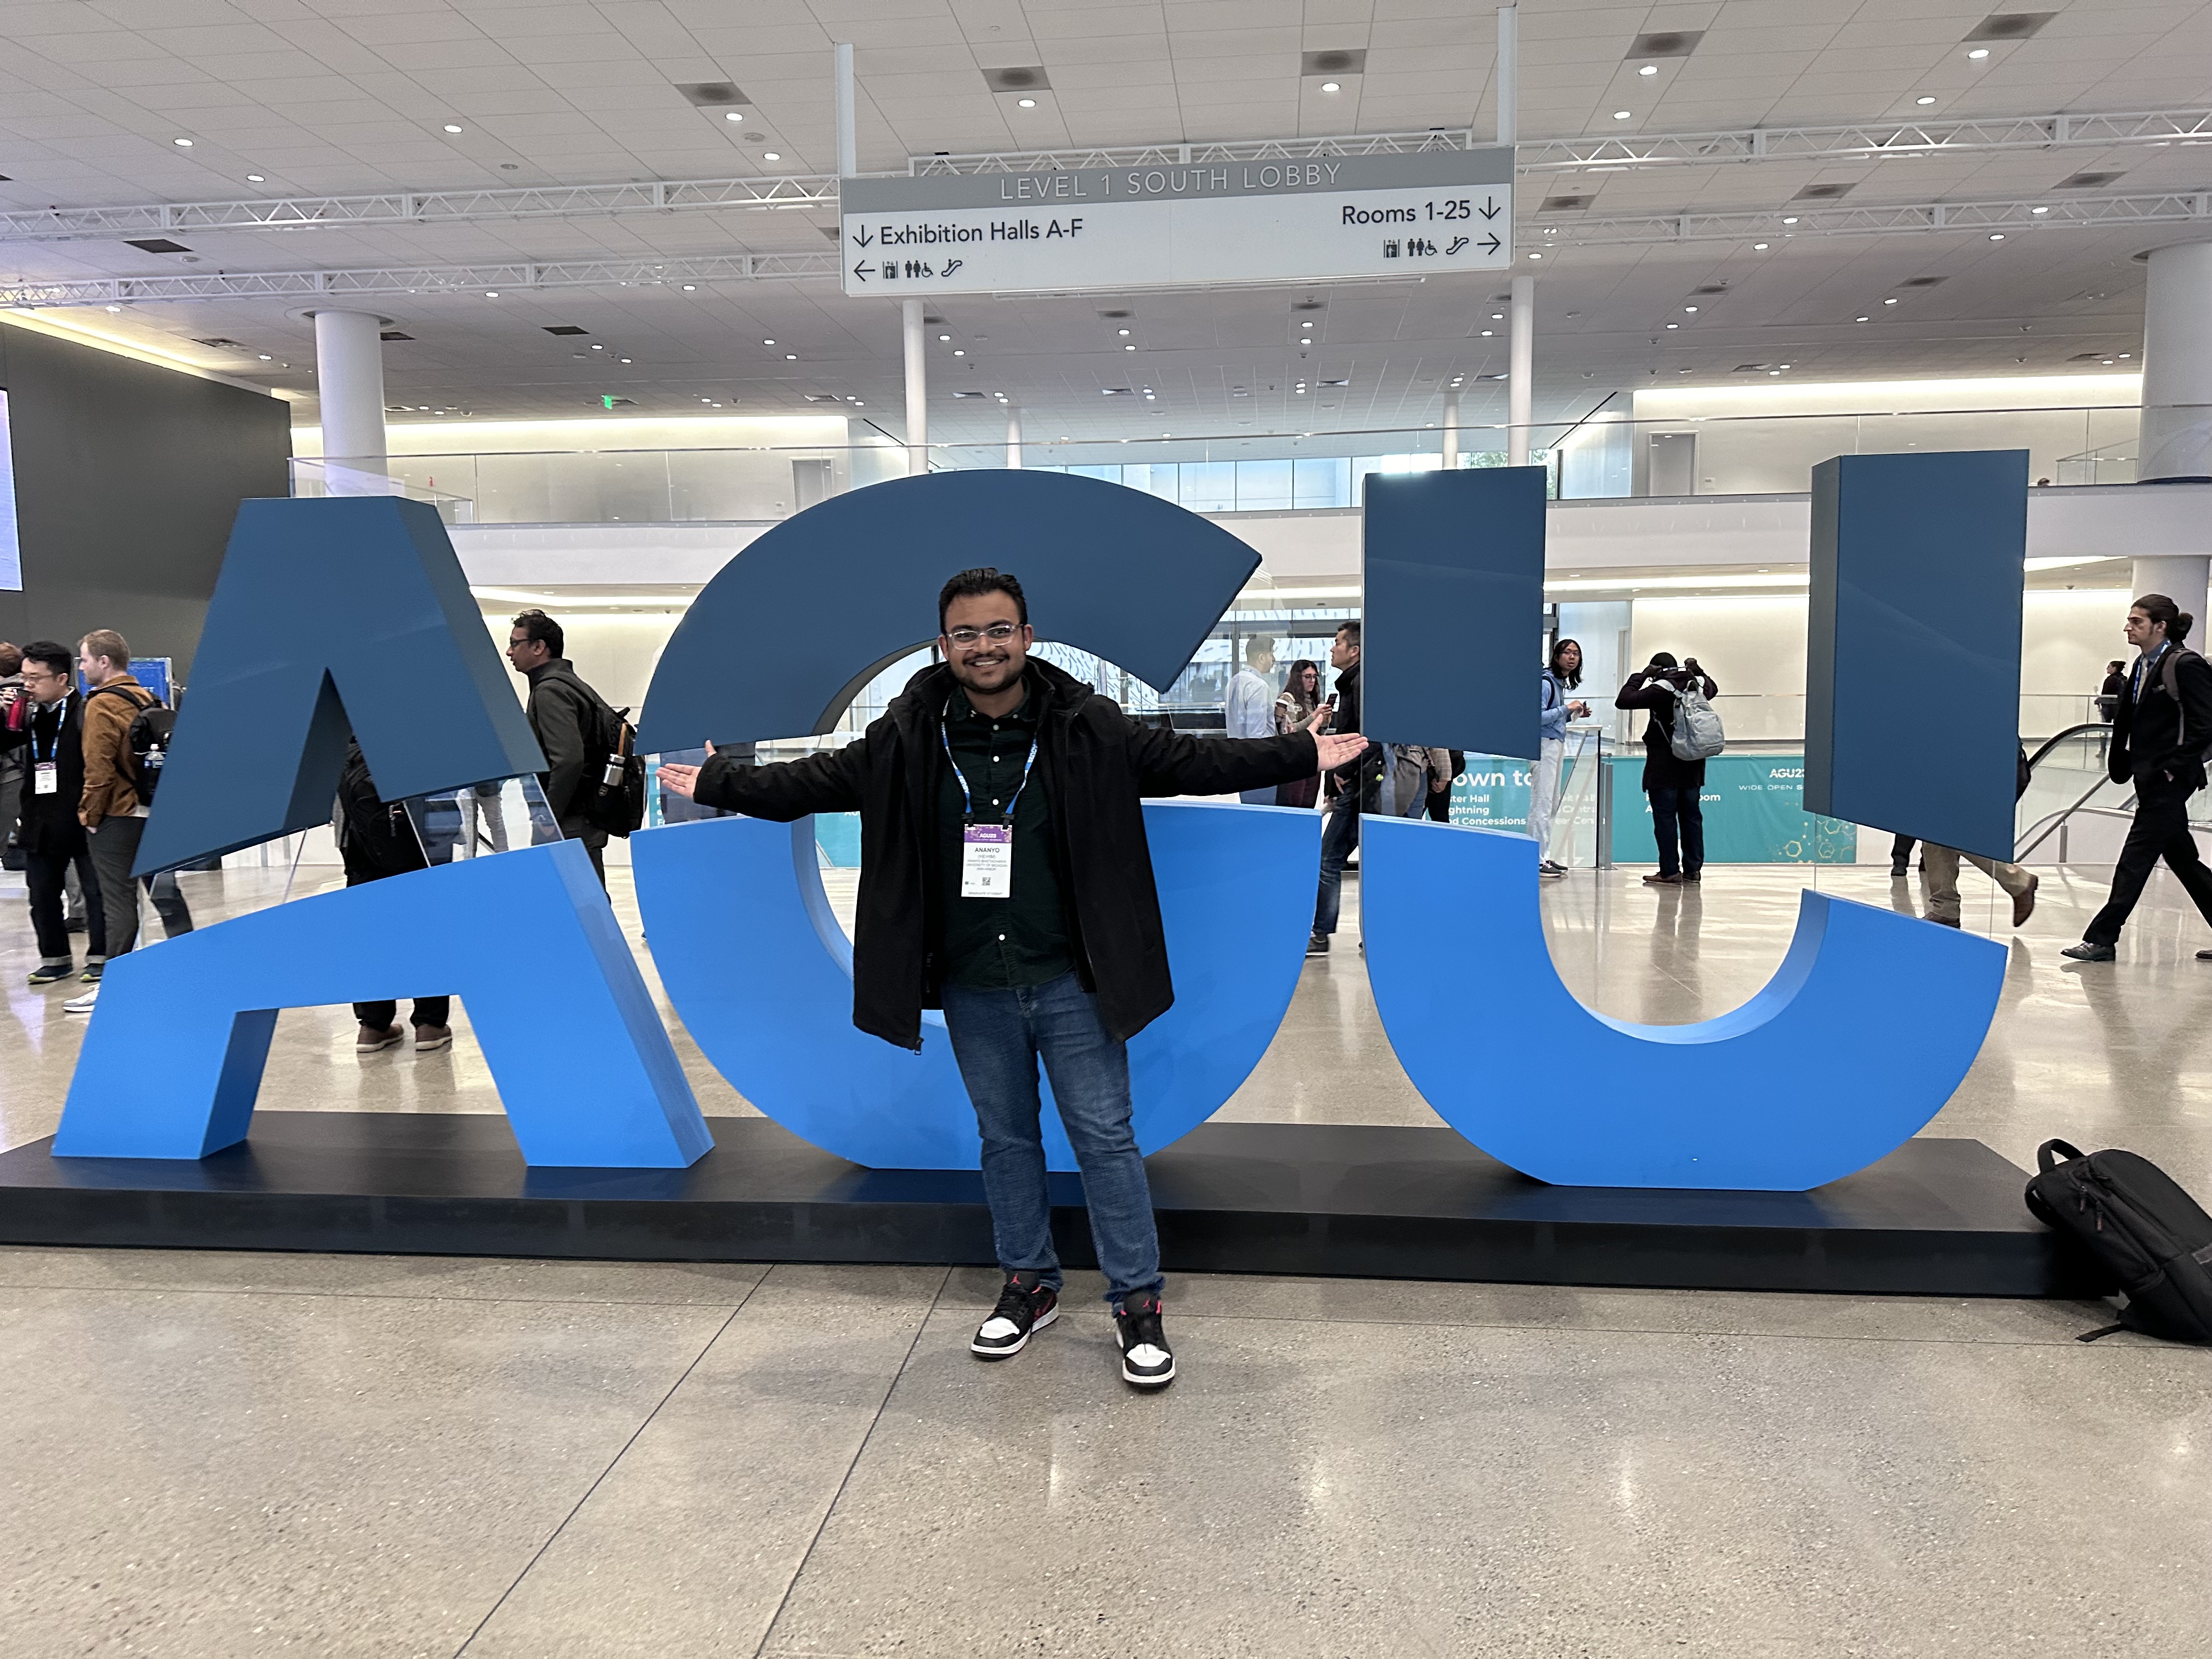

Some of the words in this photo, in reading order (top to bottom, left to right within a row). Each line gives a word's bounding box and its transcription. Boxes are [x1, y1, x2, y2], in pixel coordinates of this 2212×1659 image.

[1000, 175, 1087, 201] LEVEL
[1101, 174, 1111, 195] 1
[1127, 168, 1228, 195] SOUTH
[1243, 162, 1342, 189] LOBBY
[1342, 205, 1416, 225] Rooms
[1424, 200, 1471, 221] 1-25
[880, 223, 983, 245] Exhibition
[990, 219, 1040, 241] Halls
[1046, 218, 1083, 239] A-F
[1452, 772, 1505, 787] own
[1470, 794, 1489, 803] Hall
[1448, 805, 1489, 816] ghtning
[52, 450, 2028, 1193] AGU
[1462, 817, 1526, 825] Concessions
